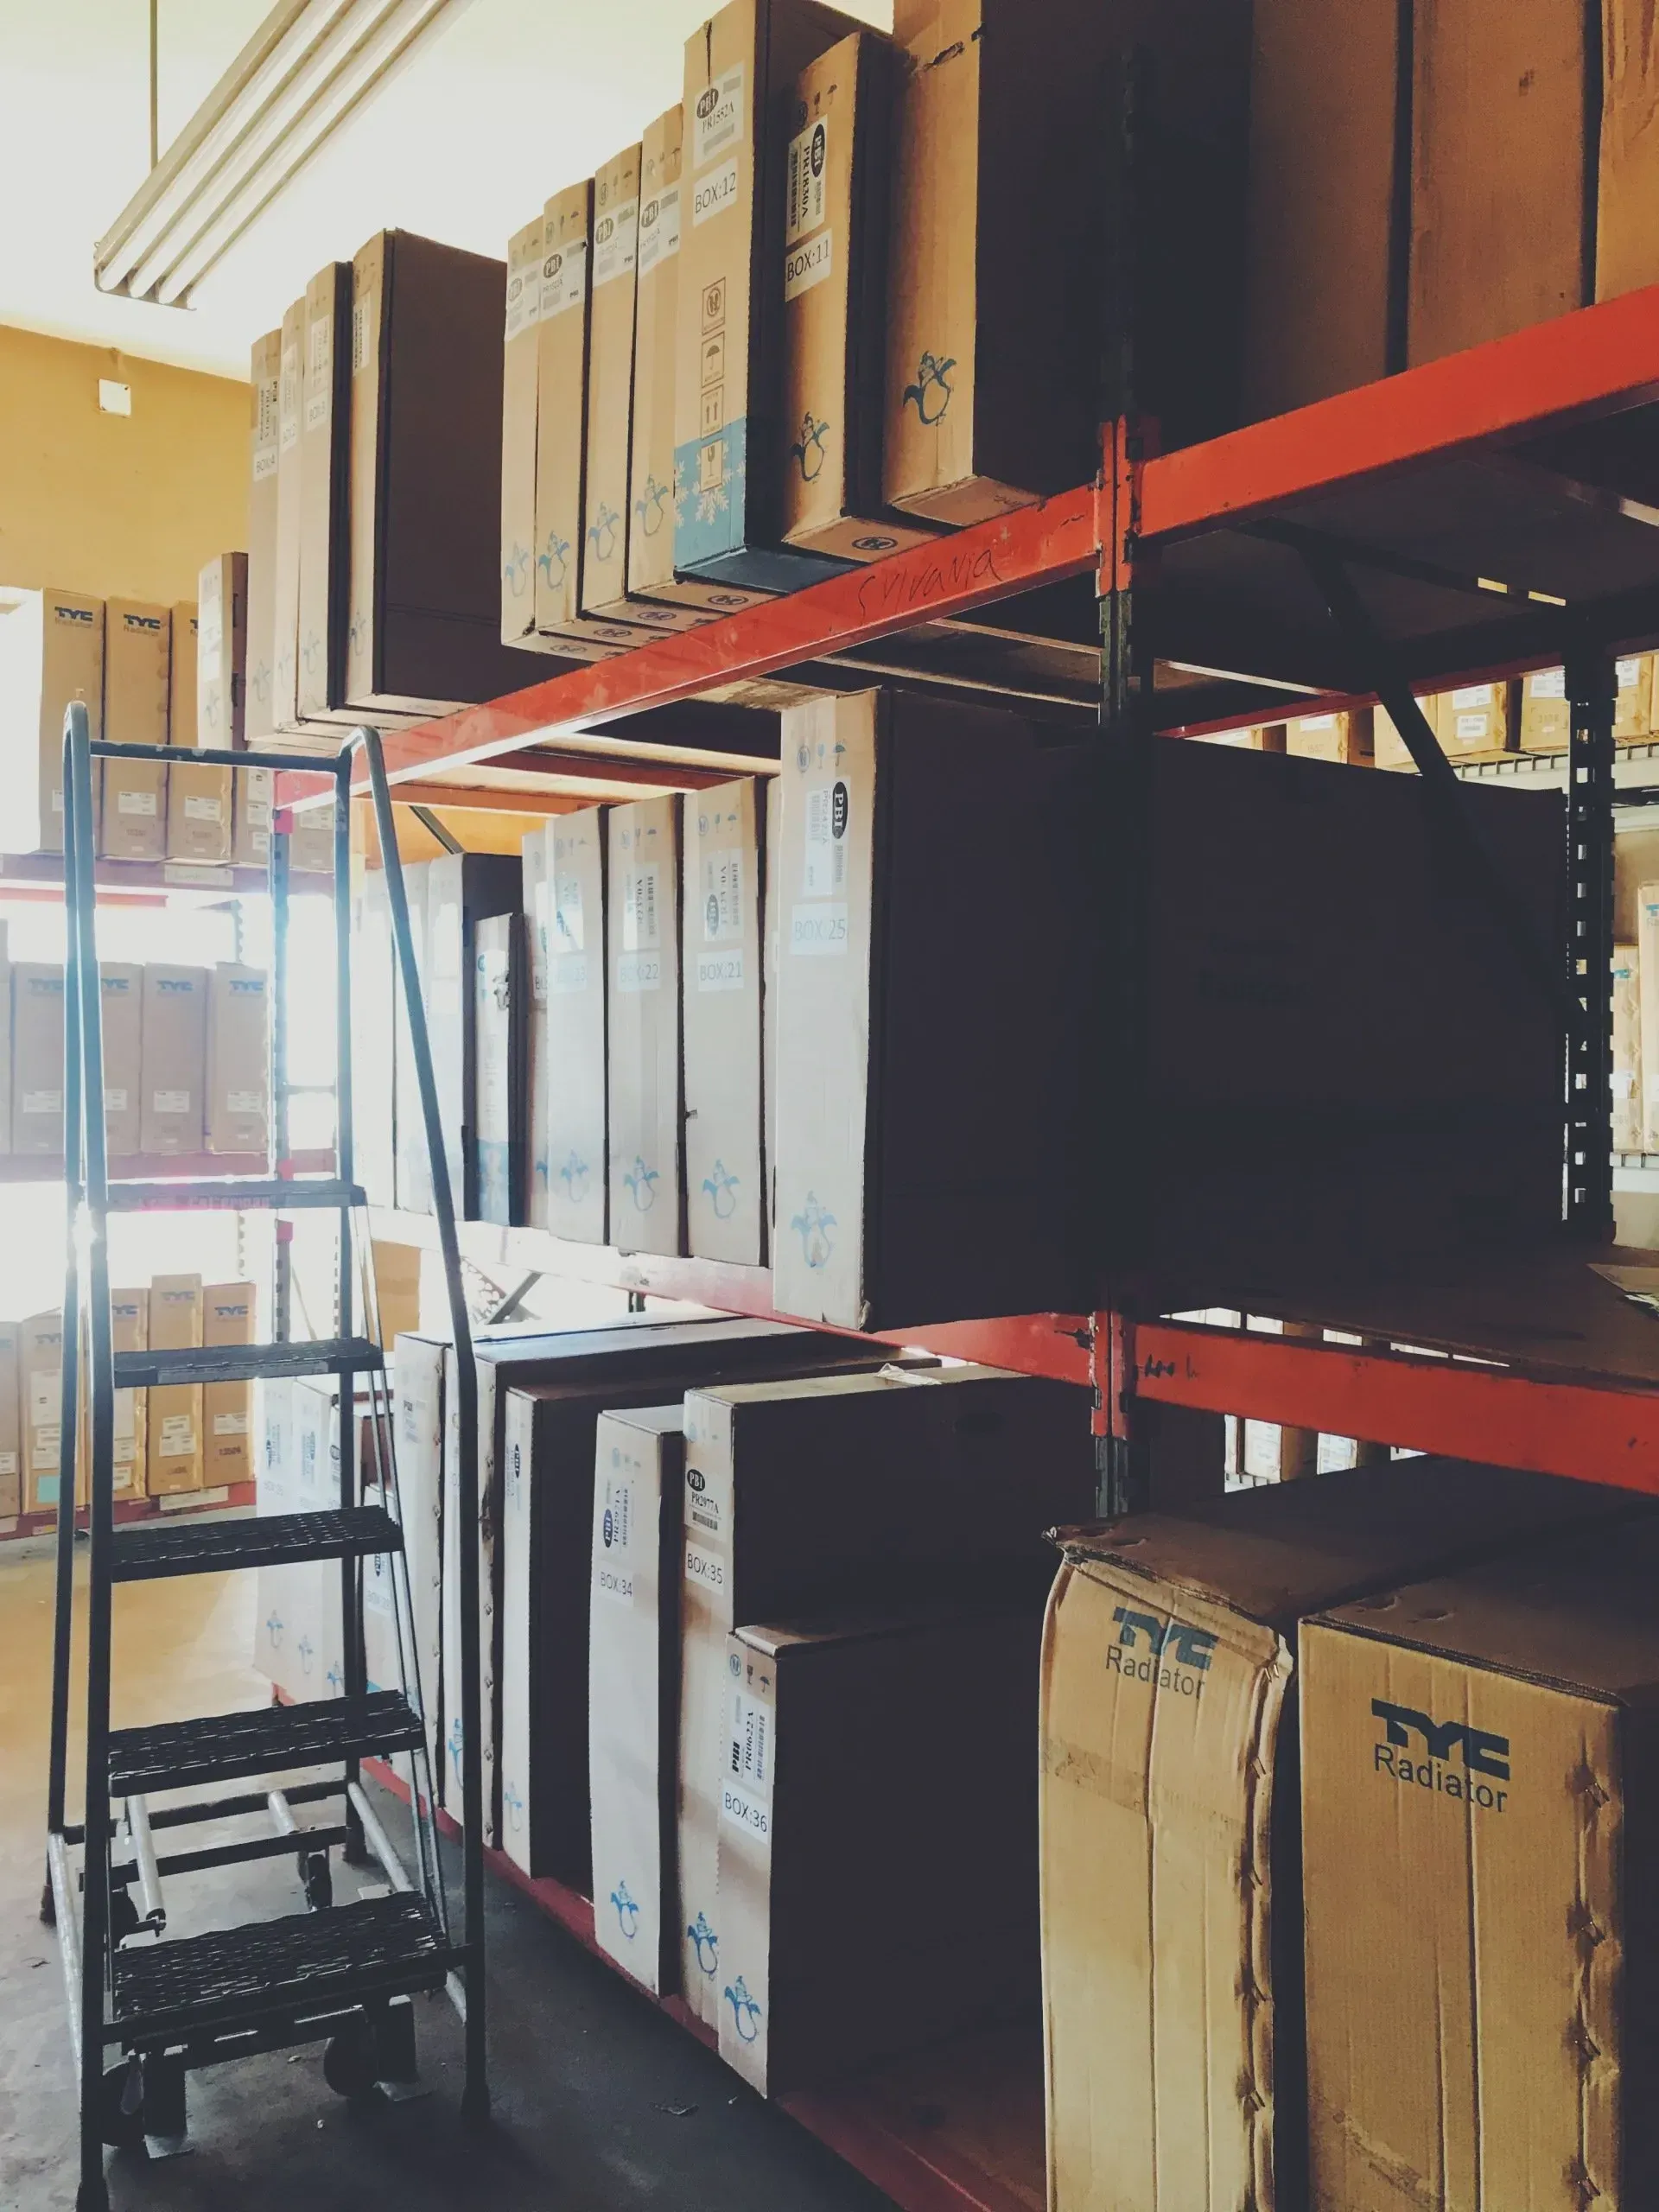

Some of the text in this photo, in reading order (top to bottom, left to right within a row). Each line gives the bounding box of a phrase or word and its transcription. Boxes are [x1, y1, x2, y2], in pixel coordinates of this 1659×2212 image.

[698, 90, 718, 117] PBI
[814, 131, 824, 170] PBI
[695, 171, 736, 214] BOX:12
[642, 202, 659, 226] PBI
[597, 219, 613, 243] PBI
[544, 256, 561, 277] PBI
[786, 238, 830, 283] BOX:11
[54, 607, 93, 622] TYC
[124, 613, 161, 630] TYC
[834, 791, 845, 829] PBI
[156, 980, 194, 992] TYC
[229, 979, 264, 992] TYC
[700, 961, 743, 982] BOX:21
[213, 1305, 249, 1316] TYC
[689, 1471, 704, 1490] PBI
[604, 1515, 613, 1544] PBI
[687, 1553, 723, 1585] BOX:35
[600, 1570, 633, 1598] BOX:34
[1112, 1606, 1218, 1671] TYC
[1105, 1644, 1206, 1700] Radiator
[745, 1711, 755, 1770] PR0622A
[1371, 1697, 1510, 1783] TYC
[731, 1739, 741, 1774] PBI
[1373, 1743, 1509, 1815] Radiator
[725, 1791, 768, 1833] BOX:36
